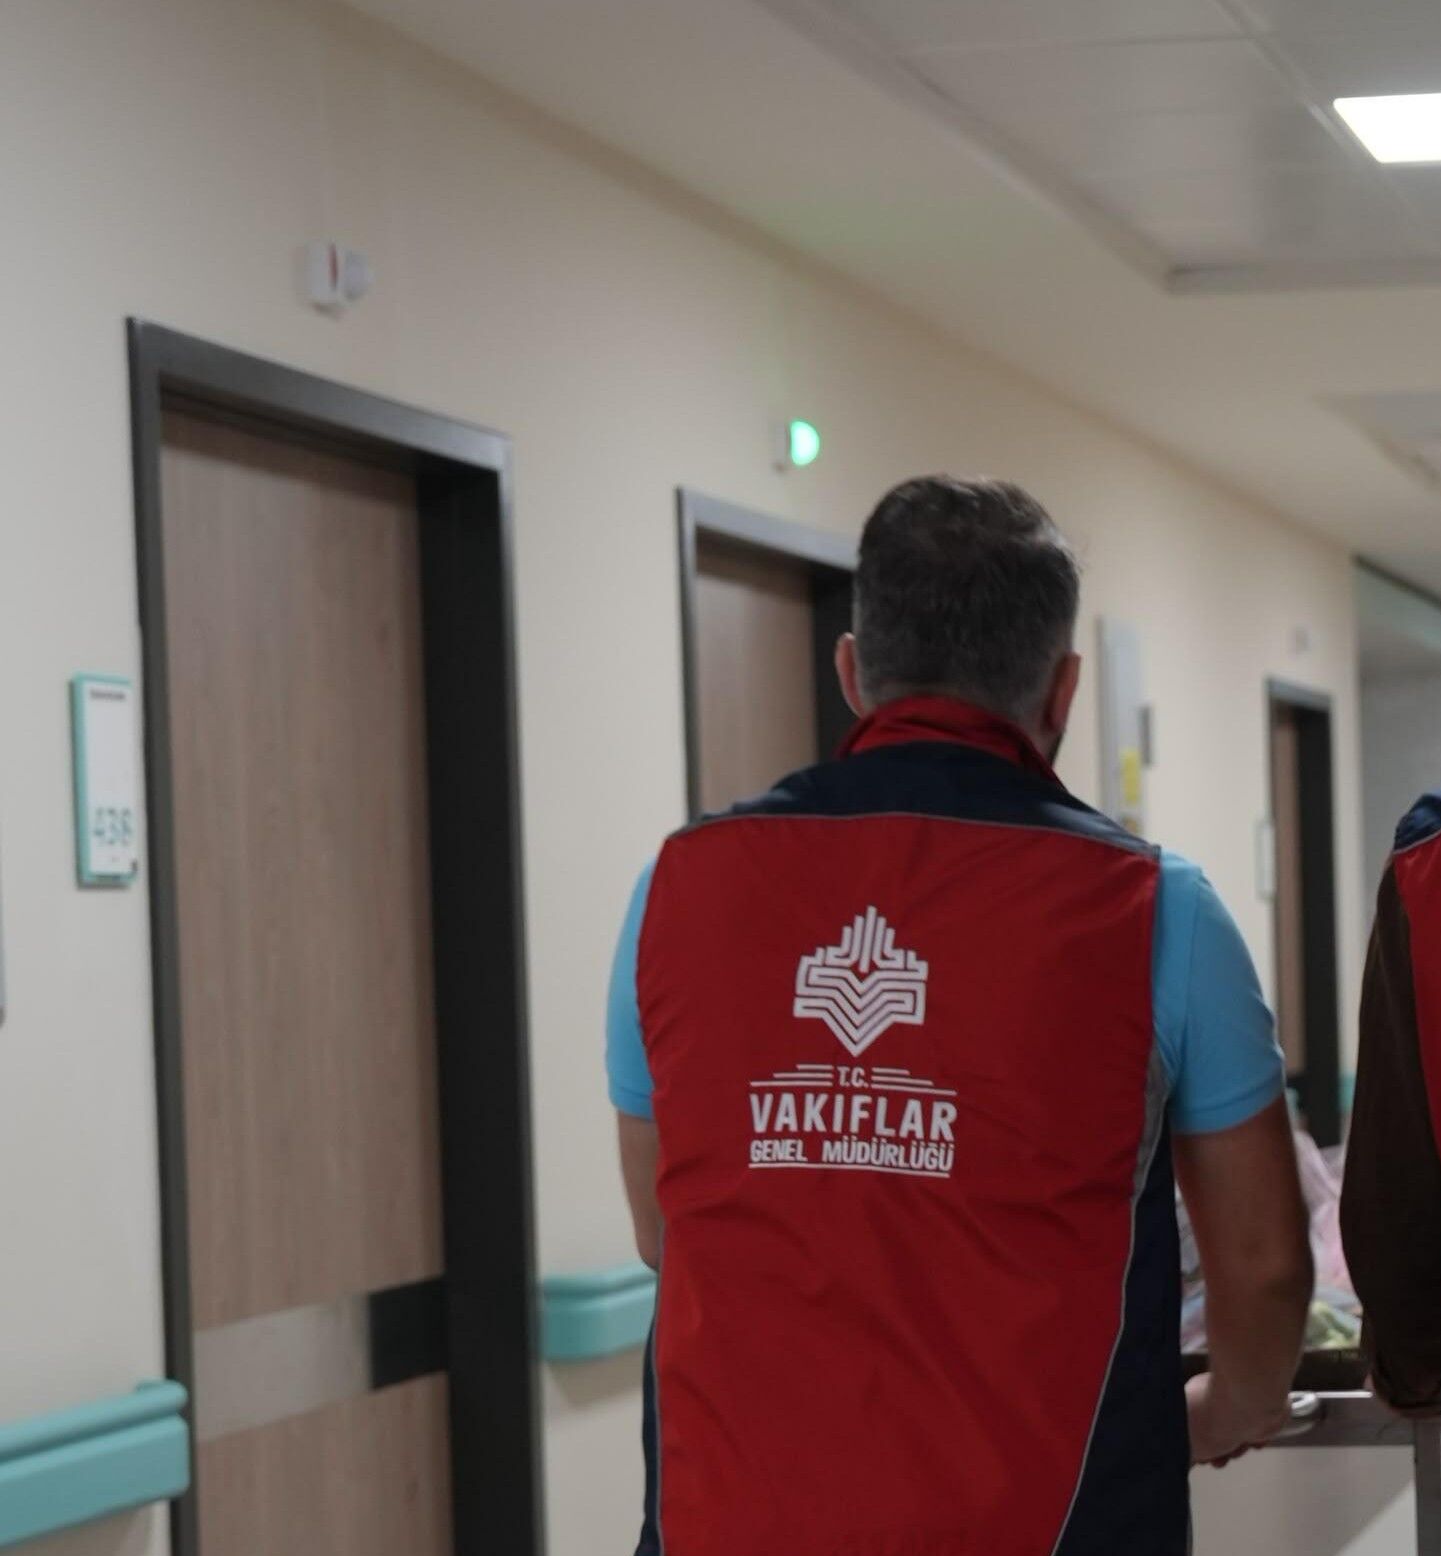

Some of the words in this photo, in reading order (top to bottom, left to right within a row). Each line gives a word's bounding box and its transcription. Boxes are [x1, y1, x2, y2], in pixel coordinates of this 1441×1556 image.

[837, 1066, 869, 1088] T.C.
[749, 1092, 958, 1141] VAKIFLAR
[750, 1139, 808, 1163] GENEL
[821, 1135, 955, 1171] MÜDÜRLÜĞÜ
